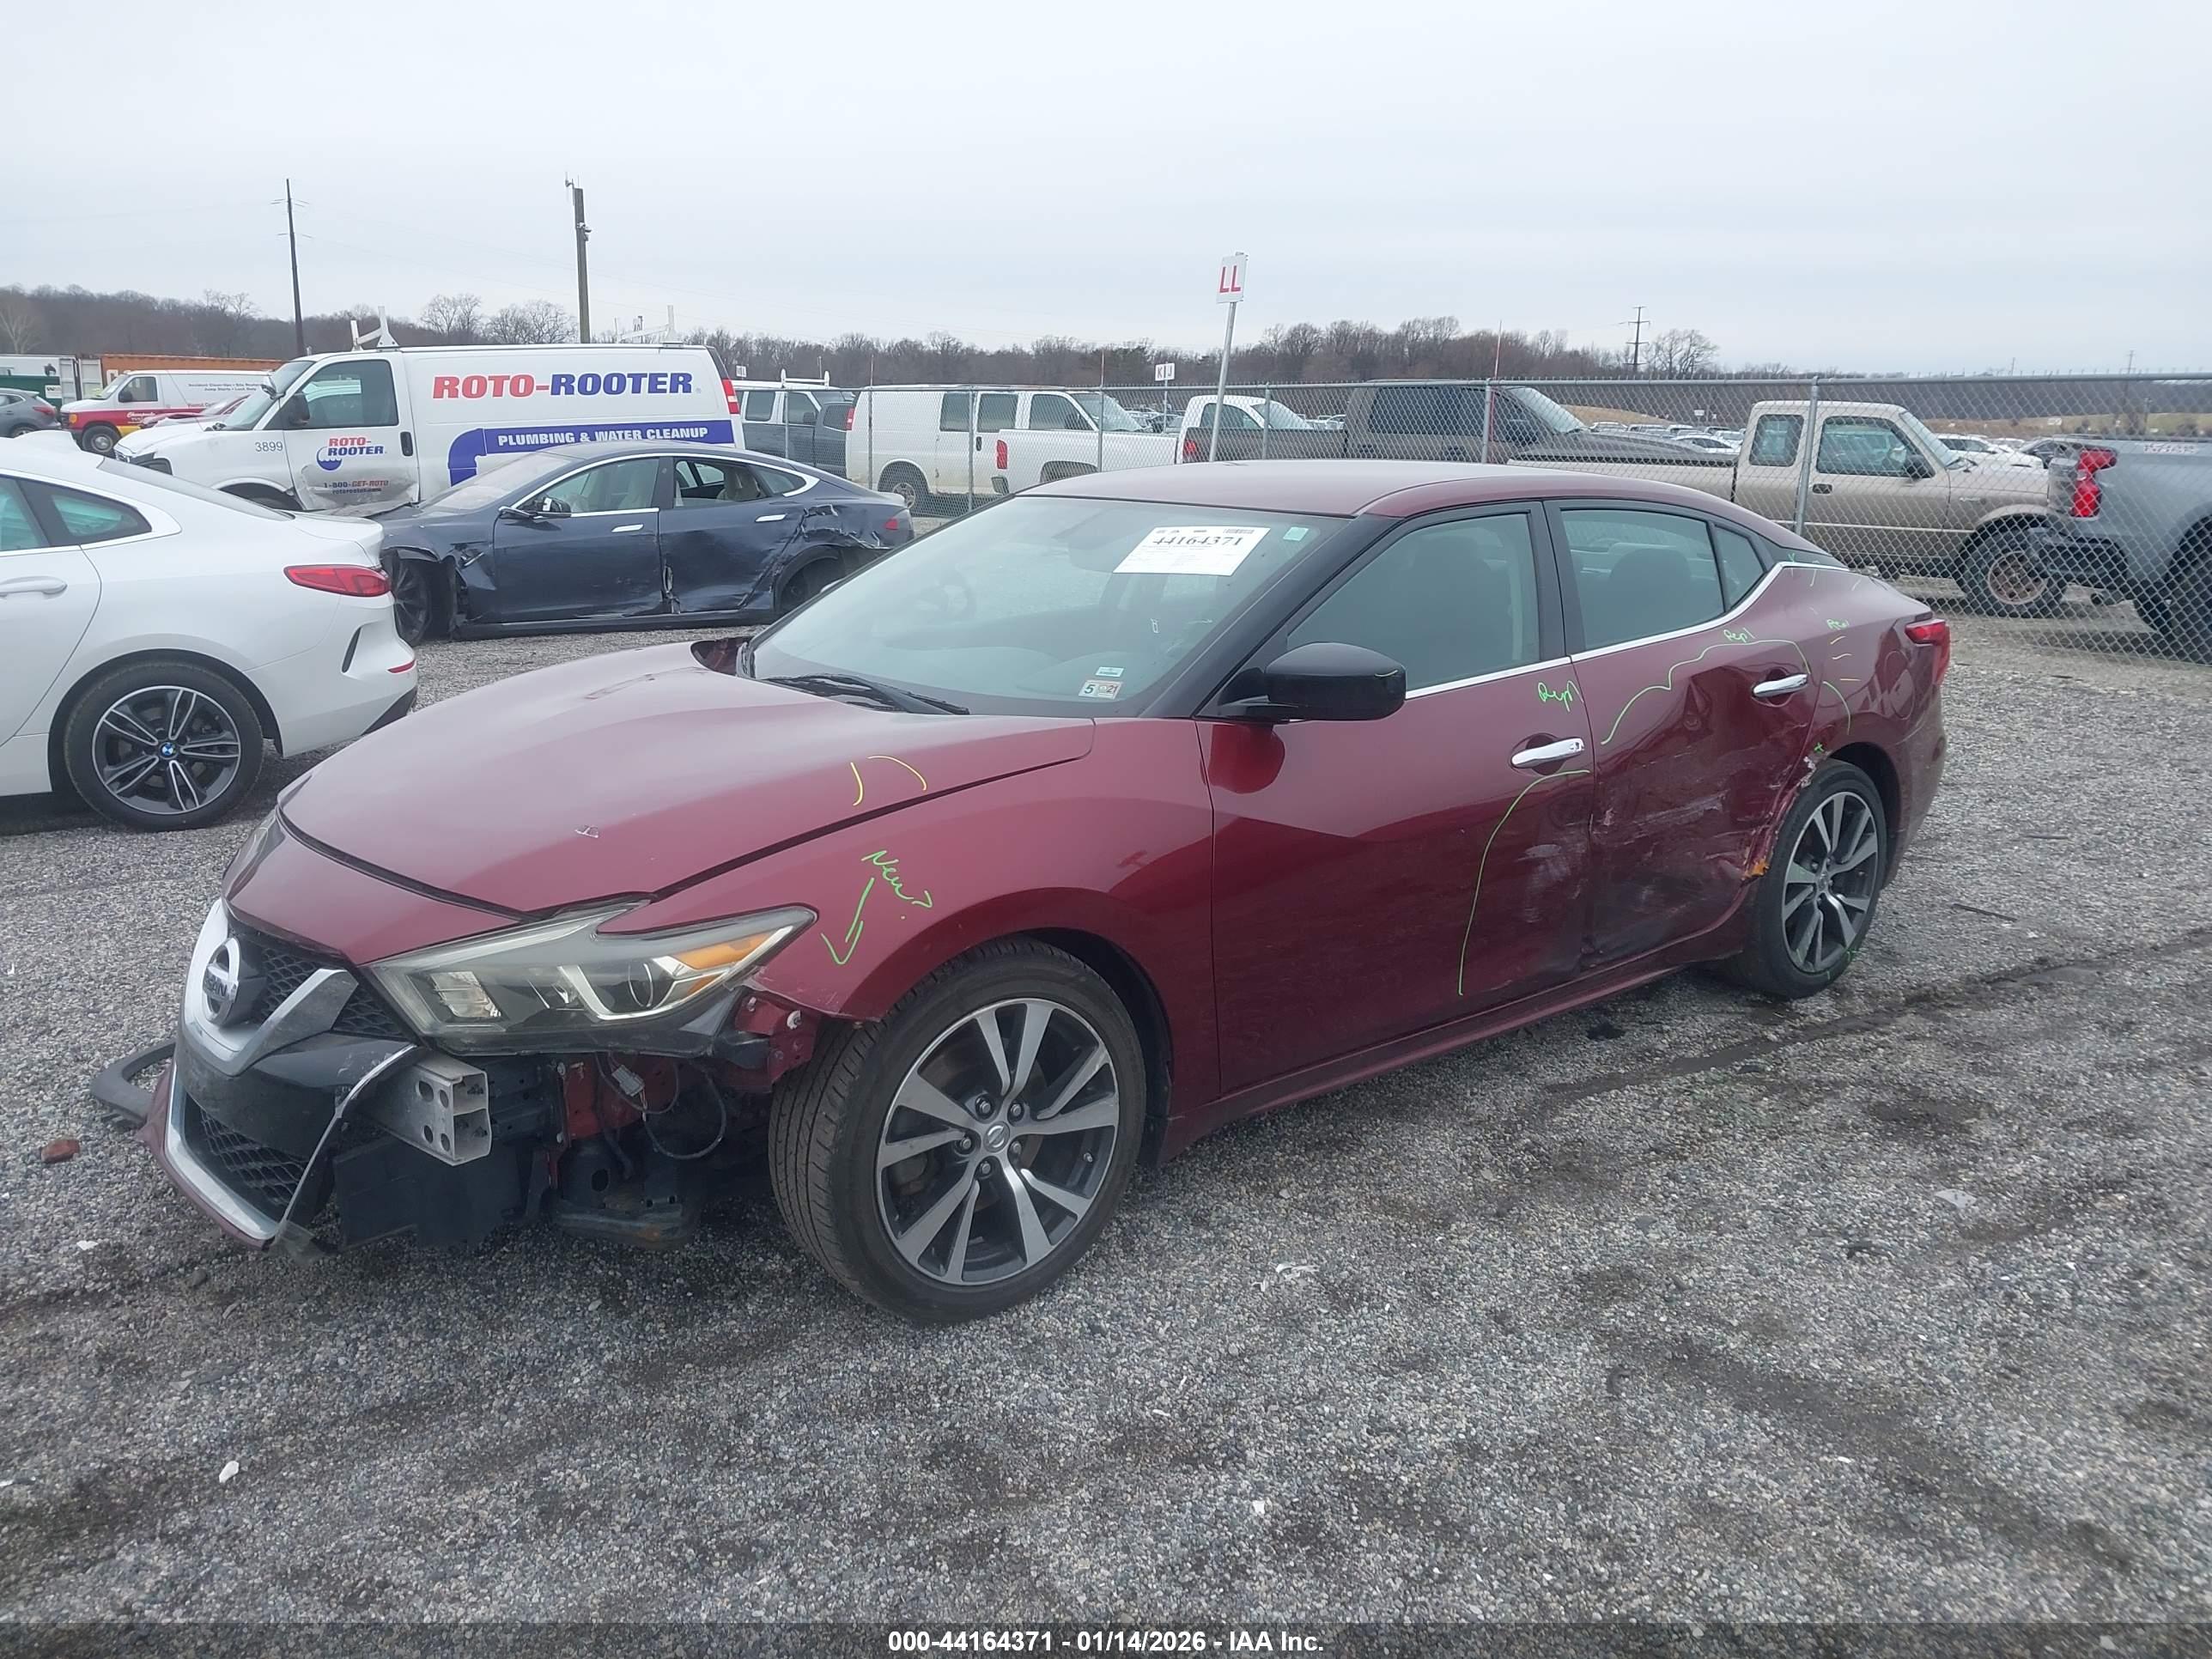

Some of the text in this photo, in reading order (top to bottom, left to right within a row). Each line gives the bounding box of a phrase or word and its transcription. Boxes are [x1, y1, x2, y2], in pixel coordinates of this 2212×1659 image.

[1218, 264, 1242, 294] LL
[432, 372, 693, 399] ROTO-ROOTER
[328, 436, 372, 447] ROTO-
[498, 427, 708, 446] PLUMBING & WATER CLEANUP
[254, 441, 283, 453] 3899
[327, 445, 384, 457] ROOTER
[1152, 535, 1243, 546] 44164371
[1084, 684, 1119, 694] 5 21
